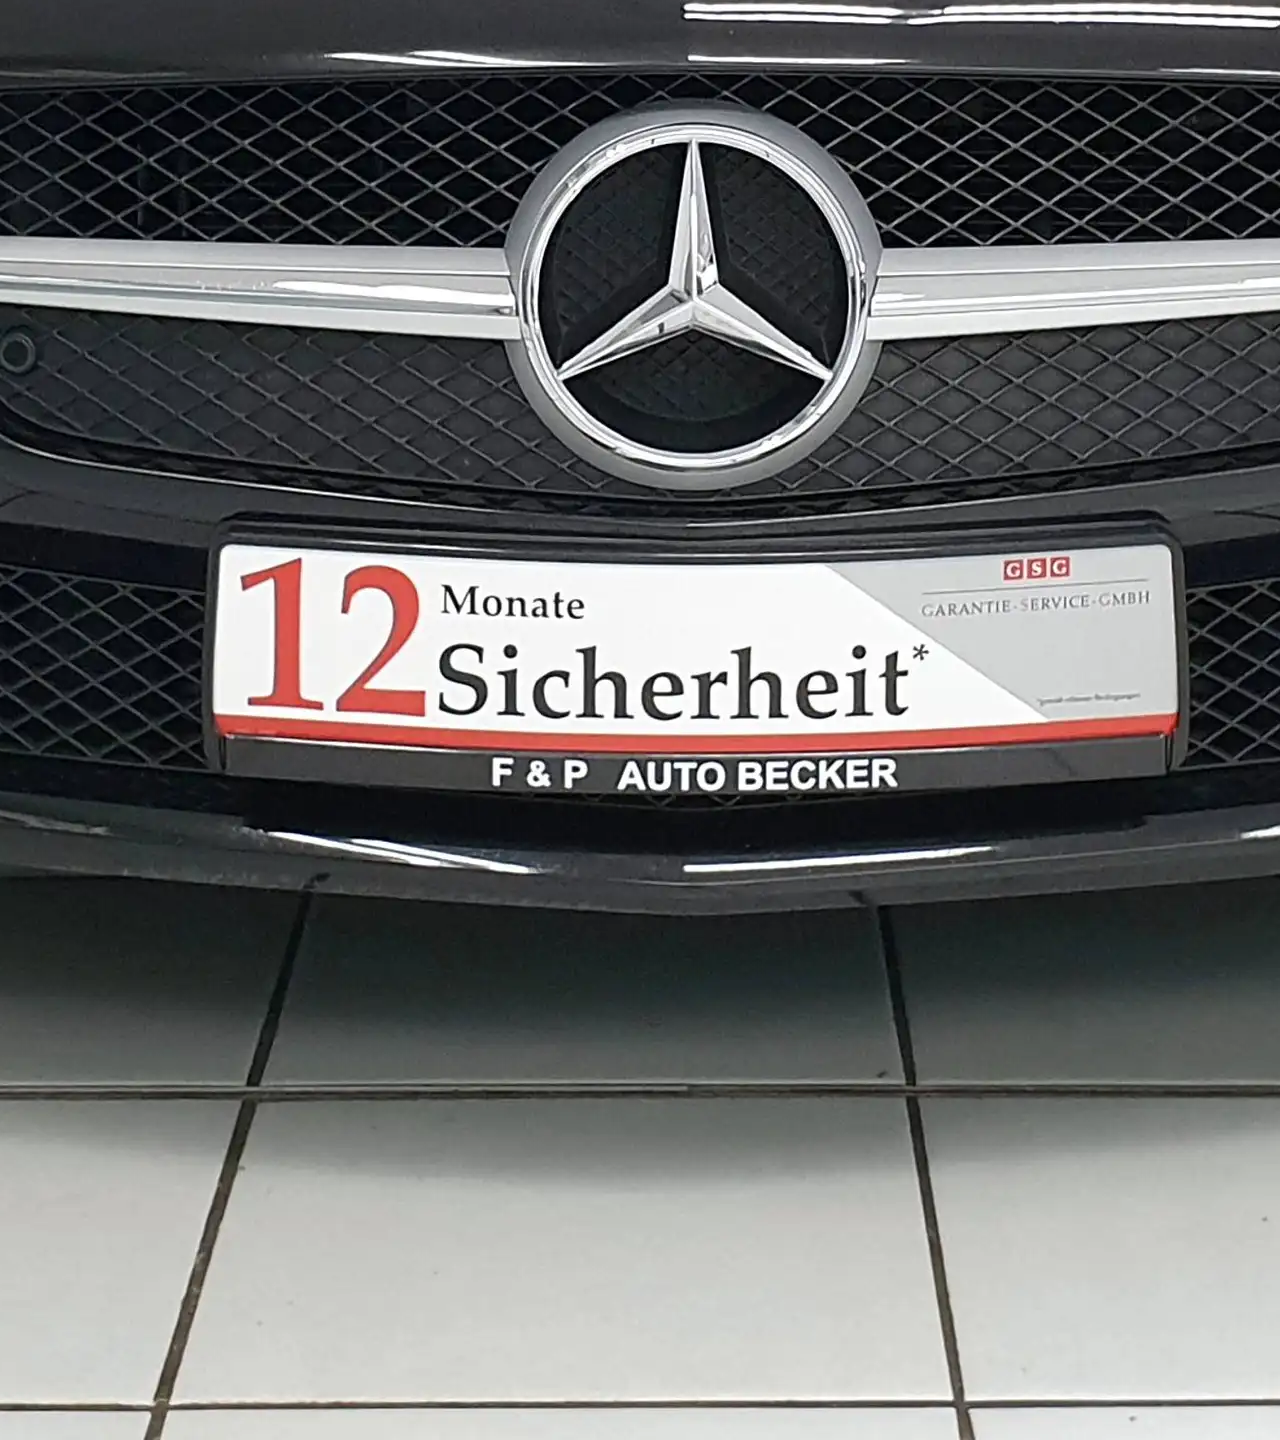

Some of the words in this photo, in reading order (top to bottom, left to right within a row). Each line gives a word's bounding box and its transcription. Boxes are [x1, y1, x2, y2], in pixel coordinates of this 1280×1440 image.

[1003, 556, 1071, 580] GSG
[441, 584, 585, 620] Monate
[240, 557, 426, 717] 12
[491, 757, 514, 788] F
[525, 760, 551, 788] &
[564, 760, 589, 790] P
[617, 759, 727, 792] AUTO
[737, 758, 899, 792] BECKER
